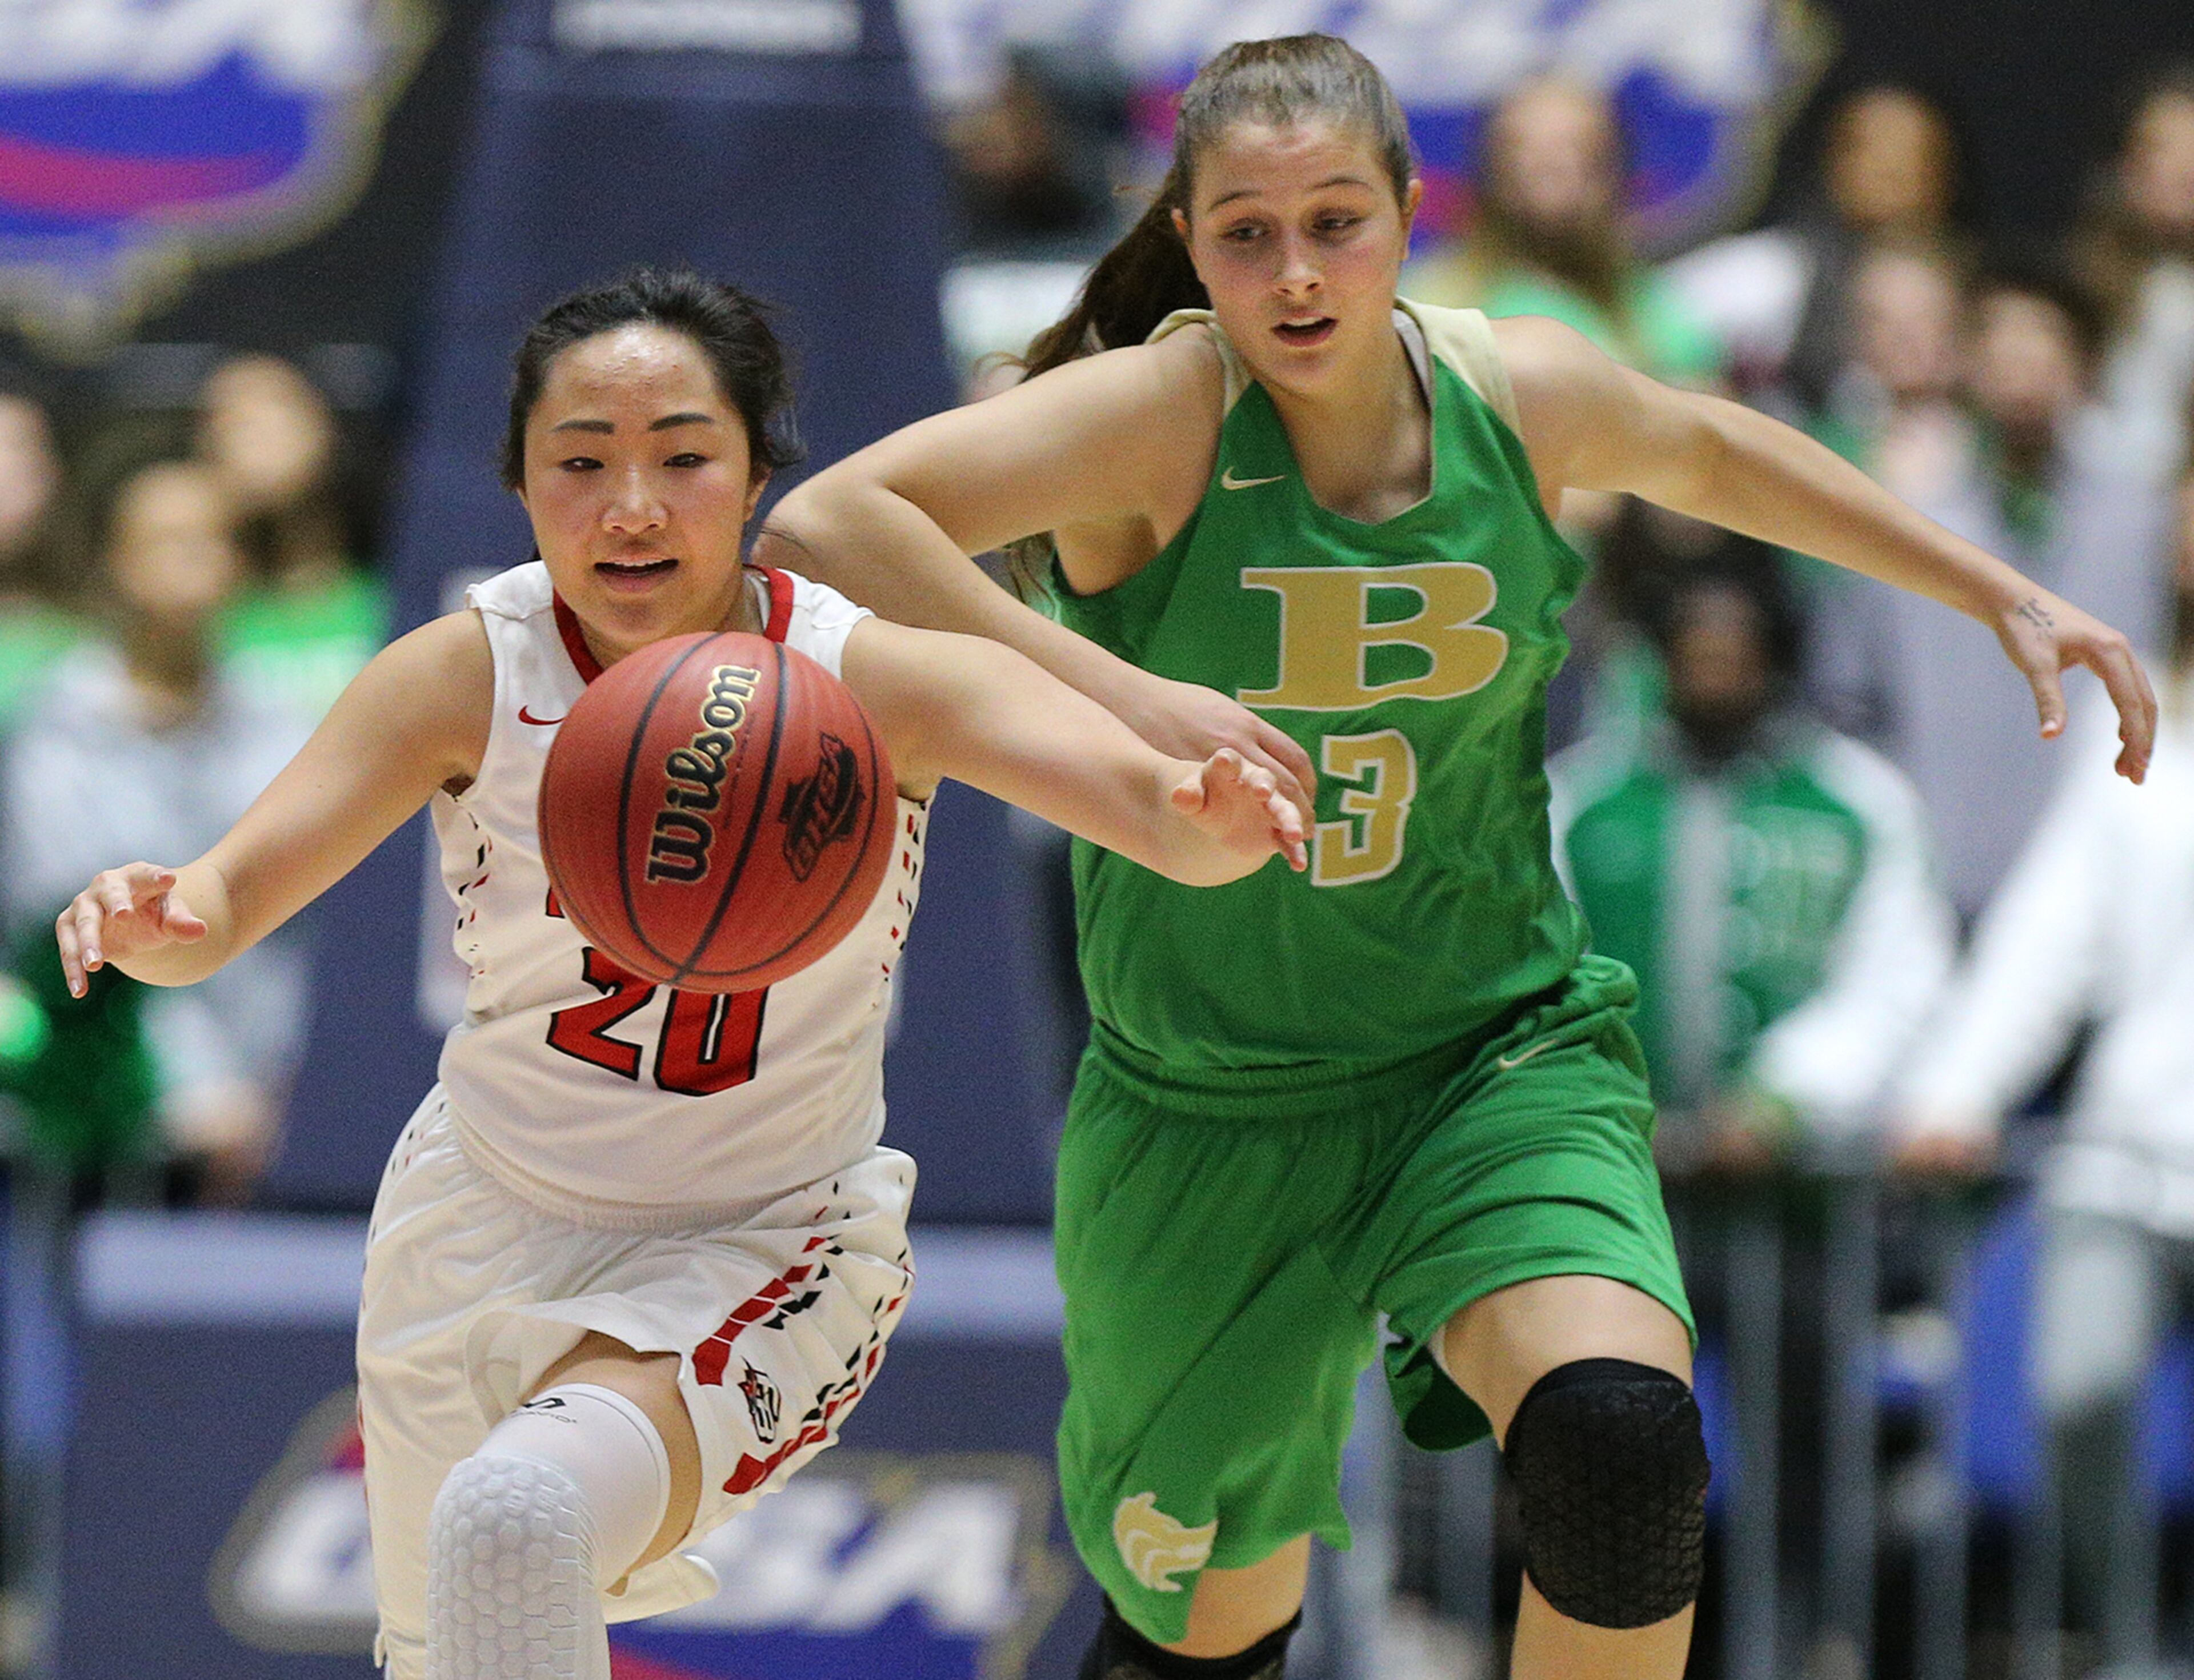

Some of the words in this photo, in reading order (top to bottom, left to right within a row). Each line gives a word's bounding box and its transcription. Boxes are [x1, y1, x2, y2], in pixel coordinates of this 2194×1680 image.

[1236, 562, 1509, 711] B
[646, 664, 761, 884] Wilson
[1311, 728, 1418, 887] 3
[546, 947, 770, 1097] 20
